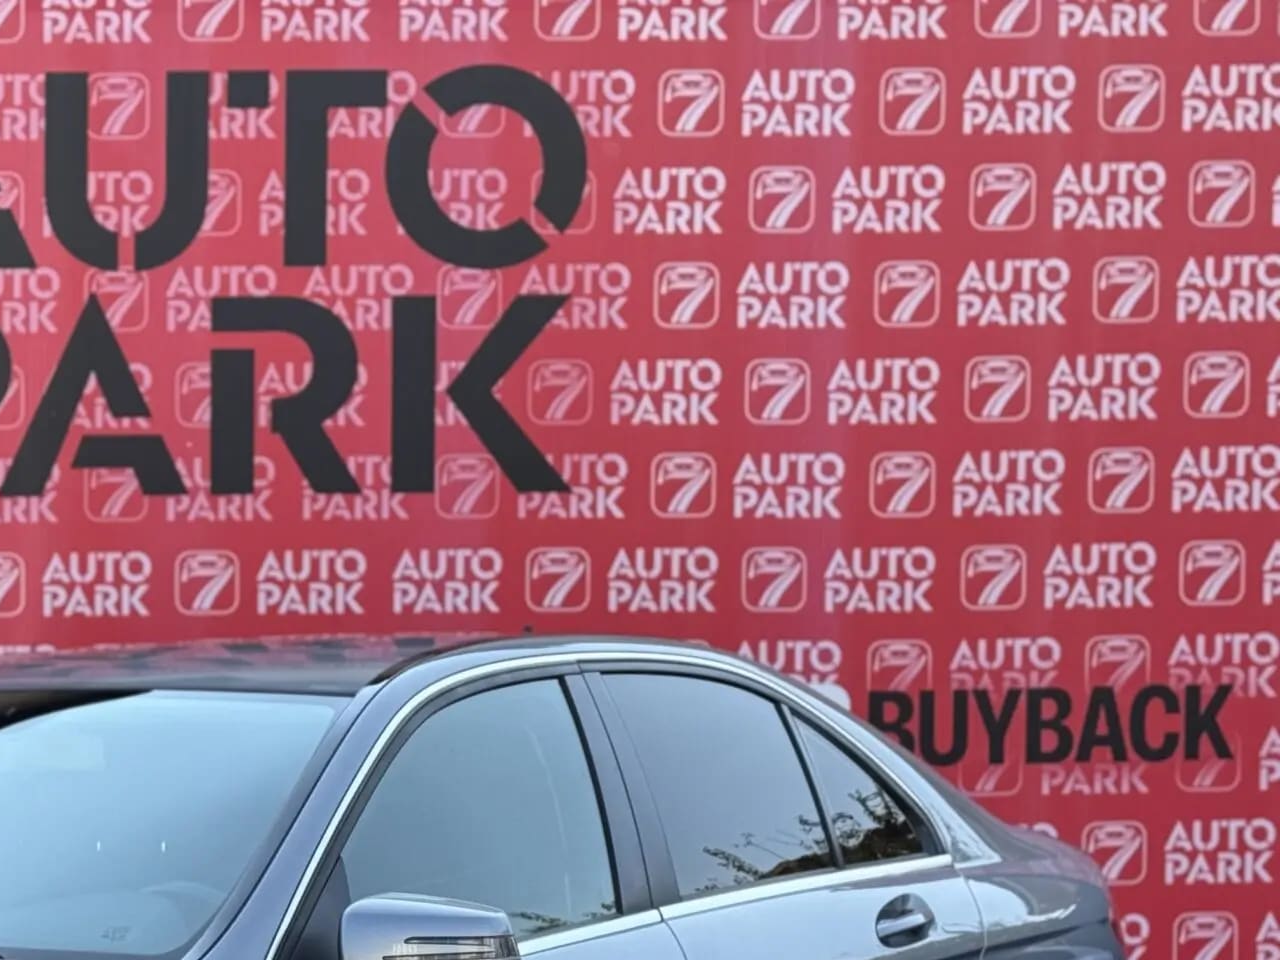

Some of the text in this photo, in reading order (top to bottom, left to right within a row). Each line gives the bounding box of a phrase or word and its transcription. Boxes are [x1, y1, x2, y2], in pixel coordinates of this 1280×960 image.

[43, 10, 151, 44] PARK
[261, 8, 369, 42] PARK
[400, 8, 508, 42] PARK
[618, 6, 727, 41] PARK
[837, 5, 946, 40] PARK
[1058, 2, 1167, 37] PARK
[549, 69, 635, 104] UTO
[742, 68, 855, 102] AUTO
[963, 65, 1076, 99] AUTO
[742, 102, 851, 137] PARK
[962, 99, 1072, 134] PARK
[614, 166, 726, 200] AUTO
[832, 164, 945, 198] AUTO
[1053, 161, 1166, 195] AUTO
[614, 200, 722, 234] PARK
[832, 198, 941, 234] PARK
[1053, 195, 1162, 230] PARK
[166, 265, 277, 298] AUTO
[302, 263, 414, 297] AUTO
[519, 263, 631, 295] AUTO
[736, 261, 850, 294] AUTO
[957, 257, 1070, 292] AUTO
[1176, 254, 1280, 288] AUTO
[737, 294, 846, 329] PARK
[957, 292, 1066, 326] PARK
[1176, 288, 1280, 322] PARK
[611, 358, 722, 391] AUTO
[827, 357, 940, 390] AUTO
[1048, 353, 1161, 386] AUTO
[611, 391, 718, 425] PARK
[828, 390, 936, 425] PARK
[1048, 386, 1157, 422] PARK
[733, 452, 845, 485] AUTO
[952, 449, 1065, 482] AUTO
[1171, 444, 1280, 478] AUTO
[166, 488, 273, 522] PARK
[733, 485, 842, 519] PARK
[953, 482, 1061, 517] PARK
[1172, 478, 1280, 512] PARK
[42, 551, 152, 583] AUTO
[257, 548, 367, 581] AUTO
[392, 548, 503, 580] AUTO
[607, 547, 719, 579] AUTO
[824, 546, 936, 579] AUTO
[1043, 541, 1157, 575] AUTO
[43, 583, 149, 617] PARK
[257, 581, 364, 615] PARK
[393, 580, 499, 614] PARK
[608, 579, 715, 612] PARK
[824, 579, 932, 613] PARK
[1044, 575, 1153, 609] PARK
[950, 636, 1061, 670] AUTO
[1168, 632, 1280, 665] AUTO
[867, 684, 1234, 768] BUYBACK
[1041, 762, 1149, 796] PARK
[1164, 818, 1276, 851] AUTO
[1165, 851, 1272, 885] PARK
